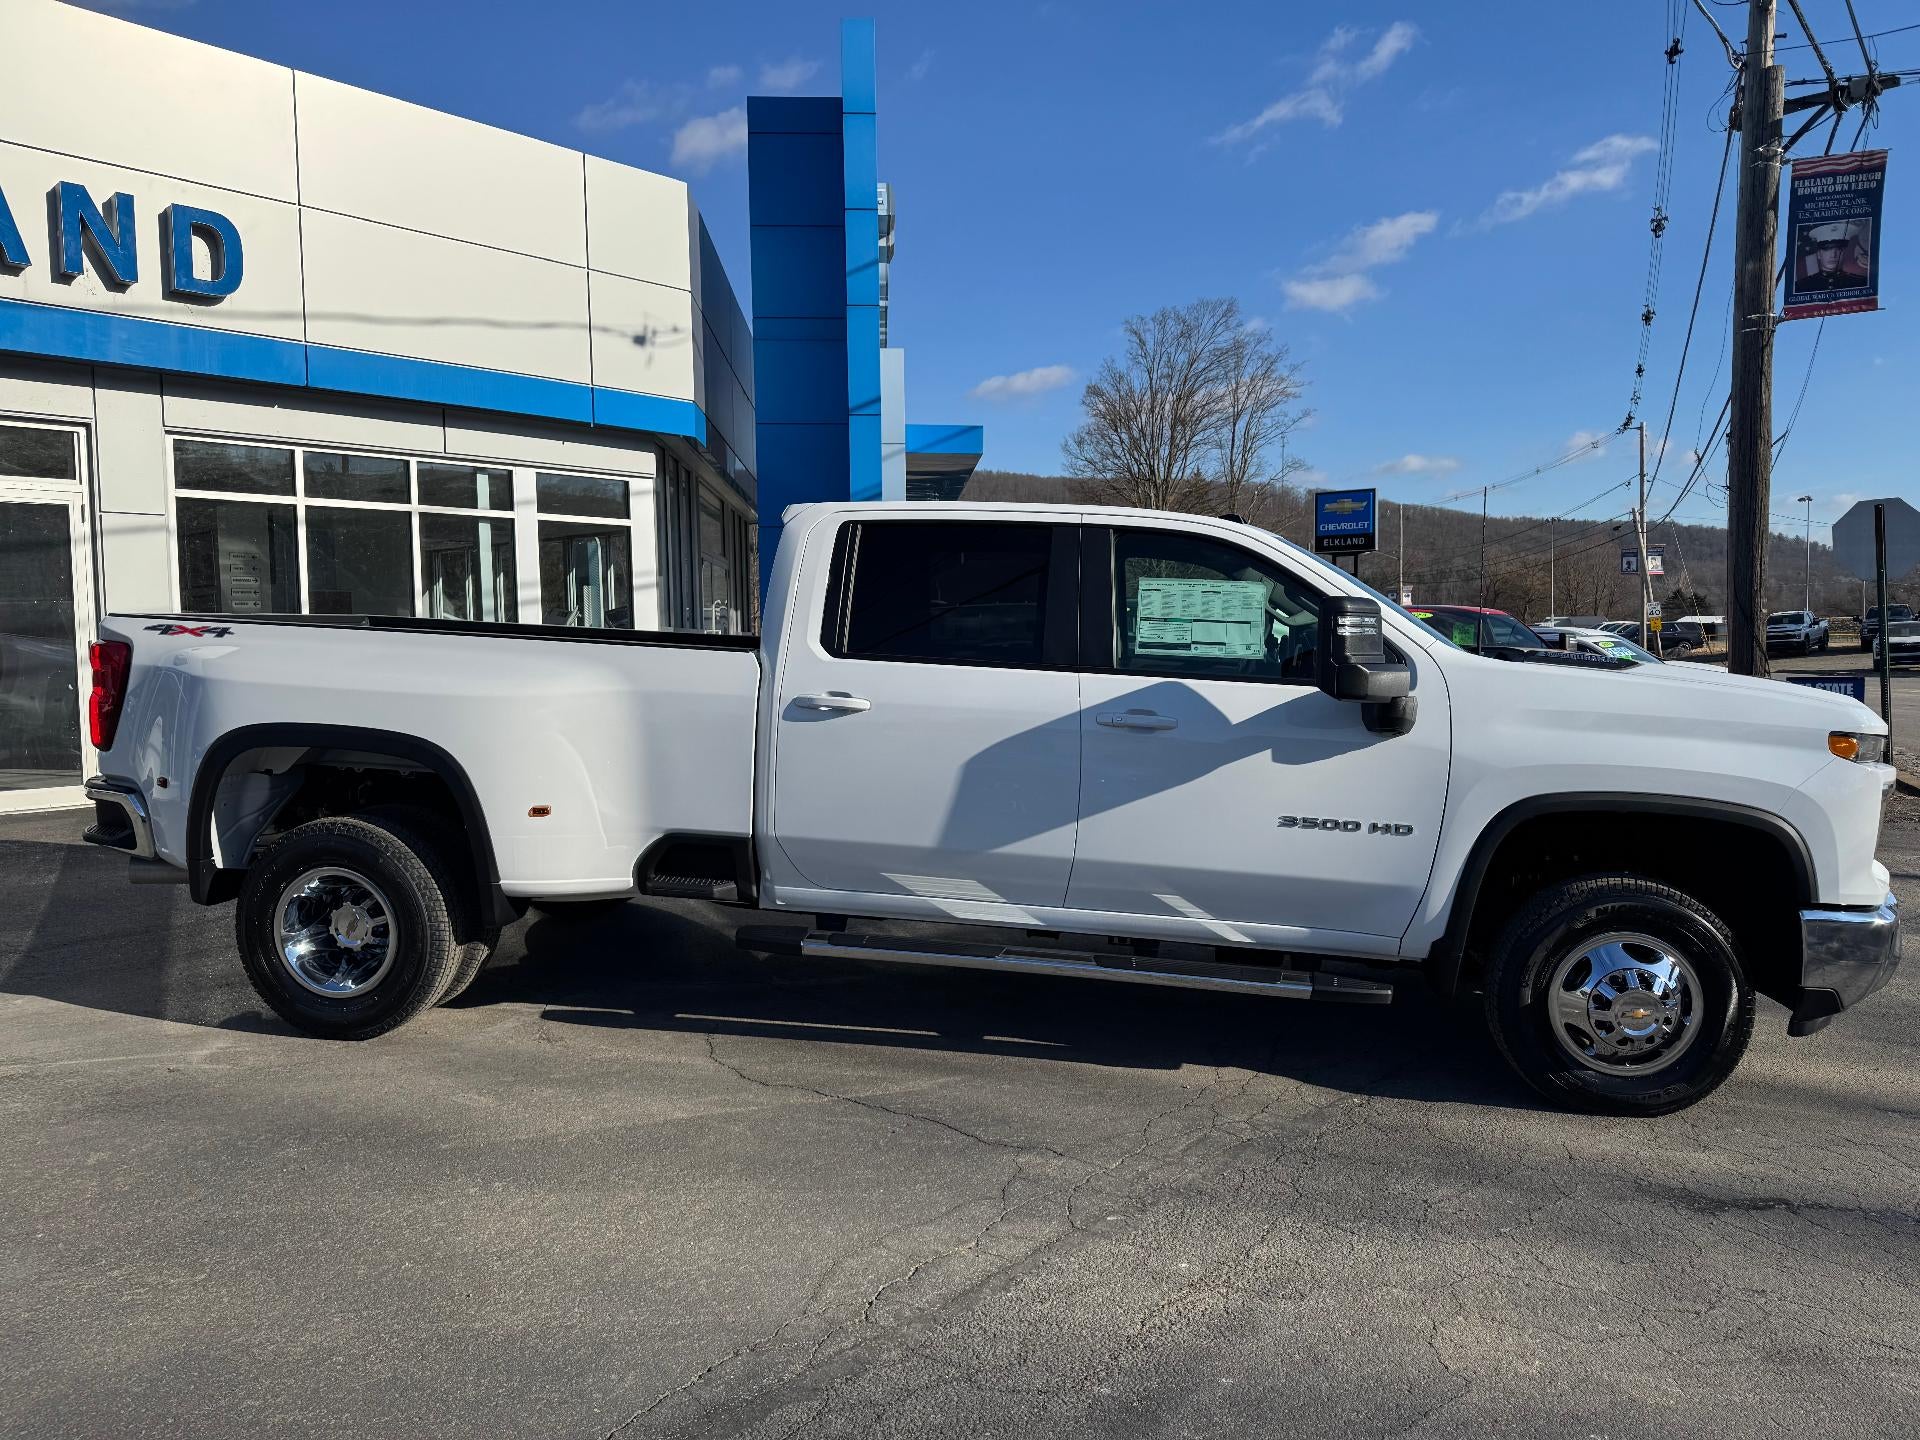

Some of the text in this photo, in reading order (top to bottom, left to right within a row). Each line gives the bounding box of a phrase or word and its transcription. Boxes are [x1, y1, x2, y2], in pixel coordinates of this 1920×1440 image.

[1794, 171, 1882, 188] ELKLAND BOROUGH
[1797, 183, 1849, 196] HOMETOWN
[1804, 200, 1839, 209] MICHAEL
[1813, 209, 1846, 218] MARINE
[1319, 521, 1369, 531] CHEVROLET
[1323, 537, 1365, 547] ELKLAND
[1815, 682, 1854, 695] STATE
[1276, 815, 1414, 837] 3500 HD
